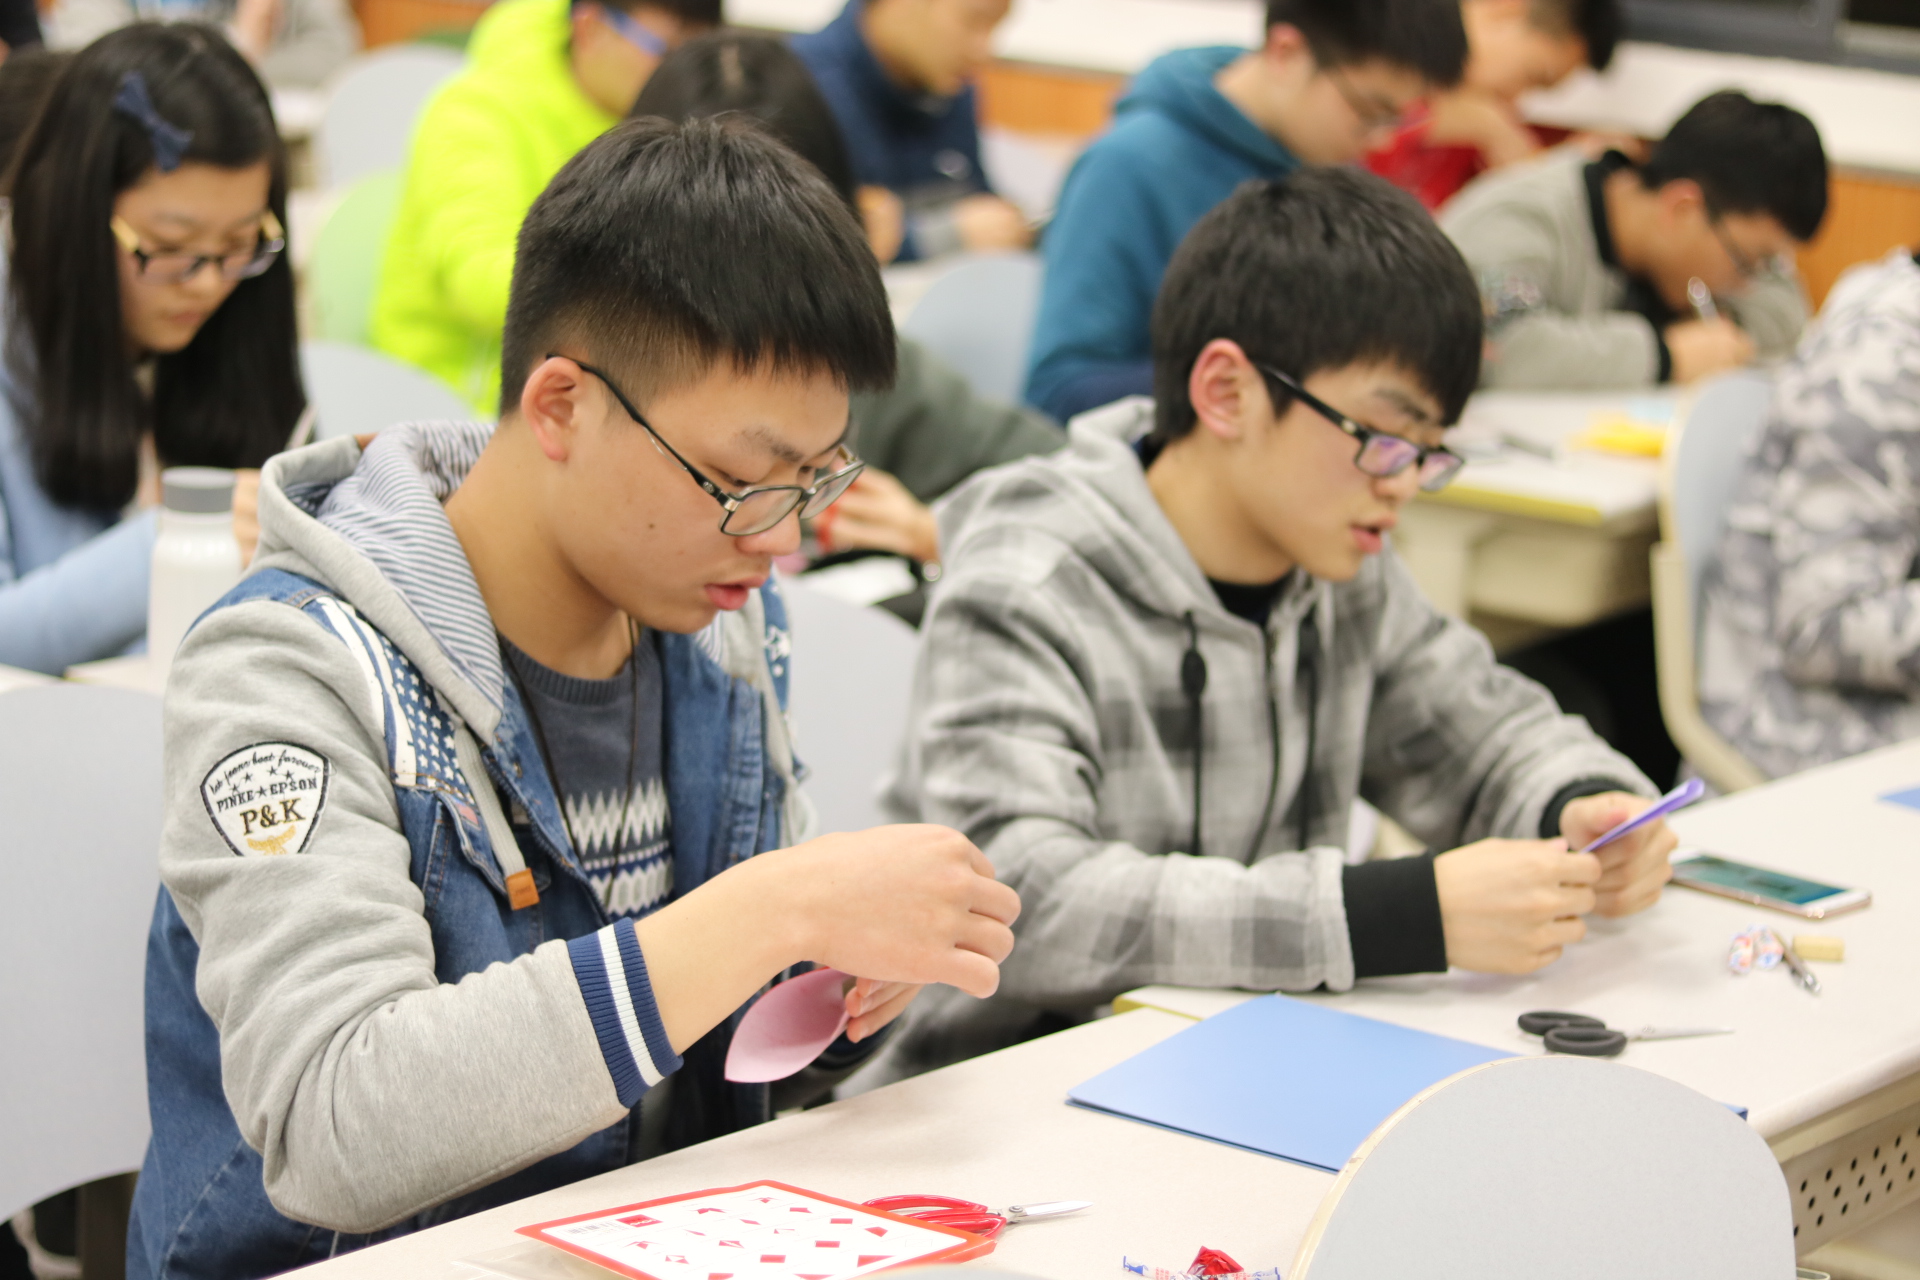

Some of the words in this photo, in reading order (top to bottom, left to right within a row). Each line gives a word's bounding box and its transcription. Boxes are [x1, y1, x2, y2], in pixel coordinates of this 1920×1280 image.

[216, 790, 255, 813] PINKE
[269, 777, 318, 796] EPSON
[239, 798, 306, 836] P&K
